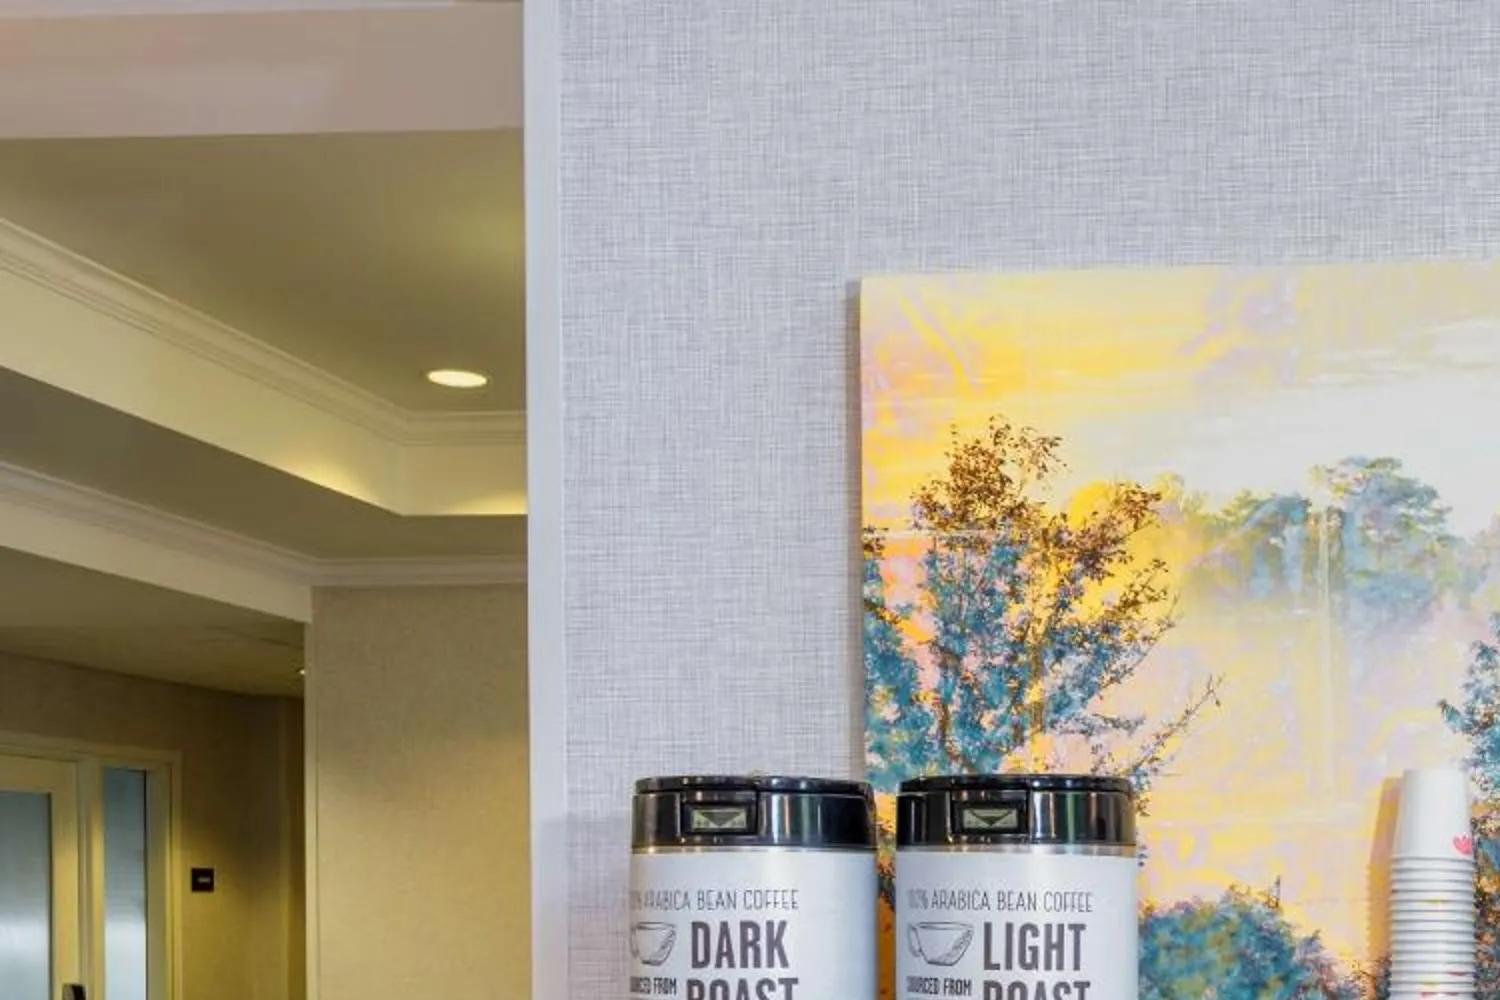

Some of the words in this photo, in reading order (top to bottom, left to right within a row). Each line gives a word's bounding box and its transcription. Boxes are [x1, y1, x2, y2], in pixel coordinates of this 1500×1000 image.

[697, 889, 737, 911] BEAN
[743, 889, 799, 910] COFFEE
[931, 889, 990, 911] ARABICA
[997, 890, 1037, 912] BEAN
[1043, 891, 1094, 912] COFFEE
[691, 920, 790, 969] DARK
[983, 922, 1087, 971] LIGHT
[943, 978, 972, 996] FROM
